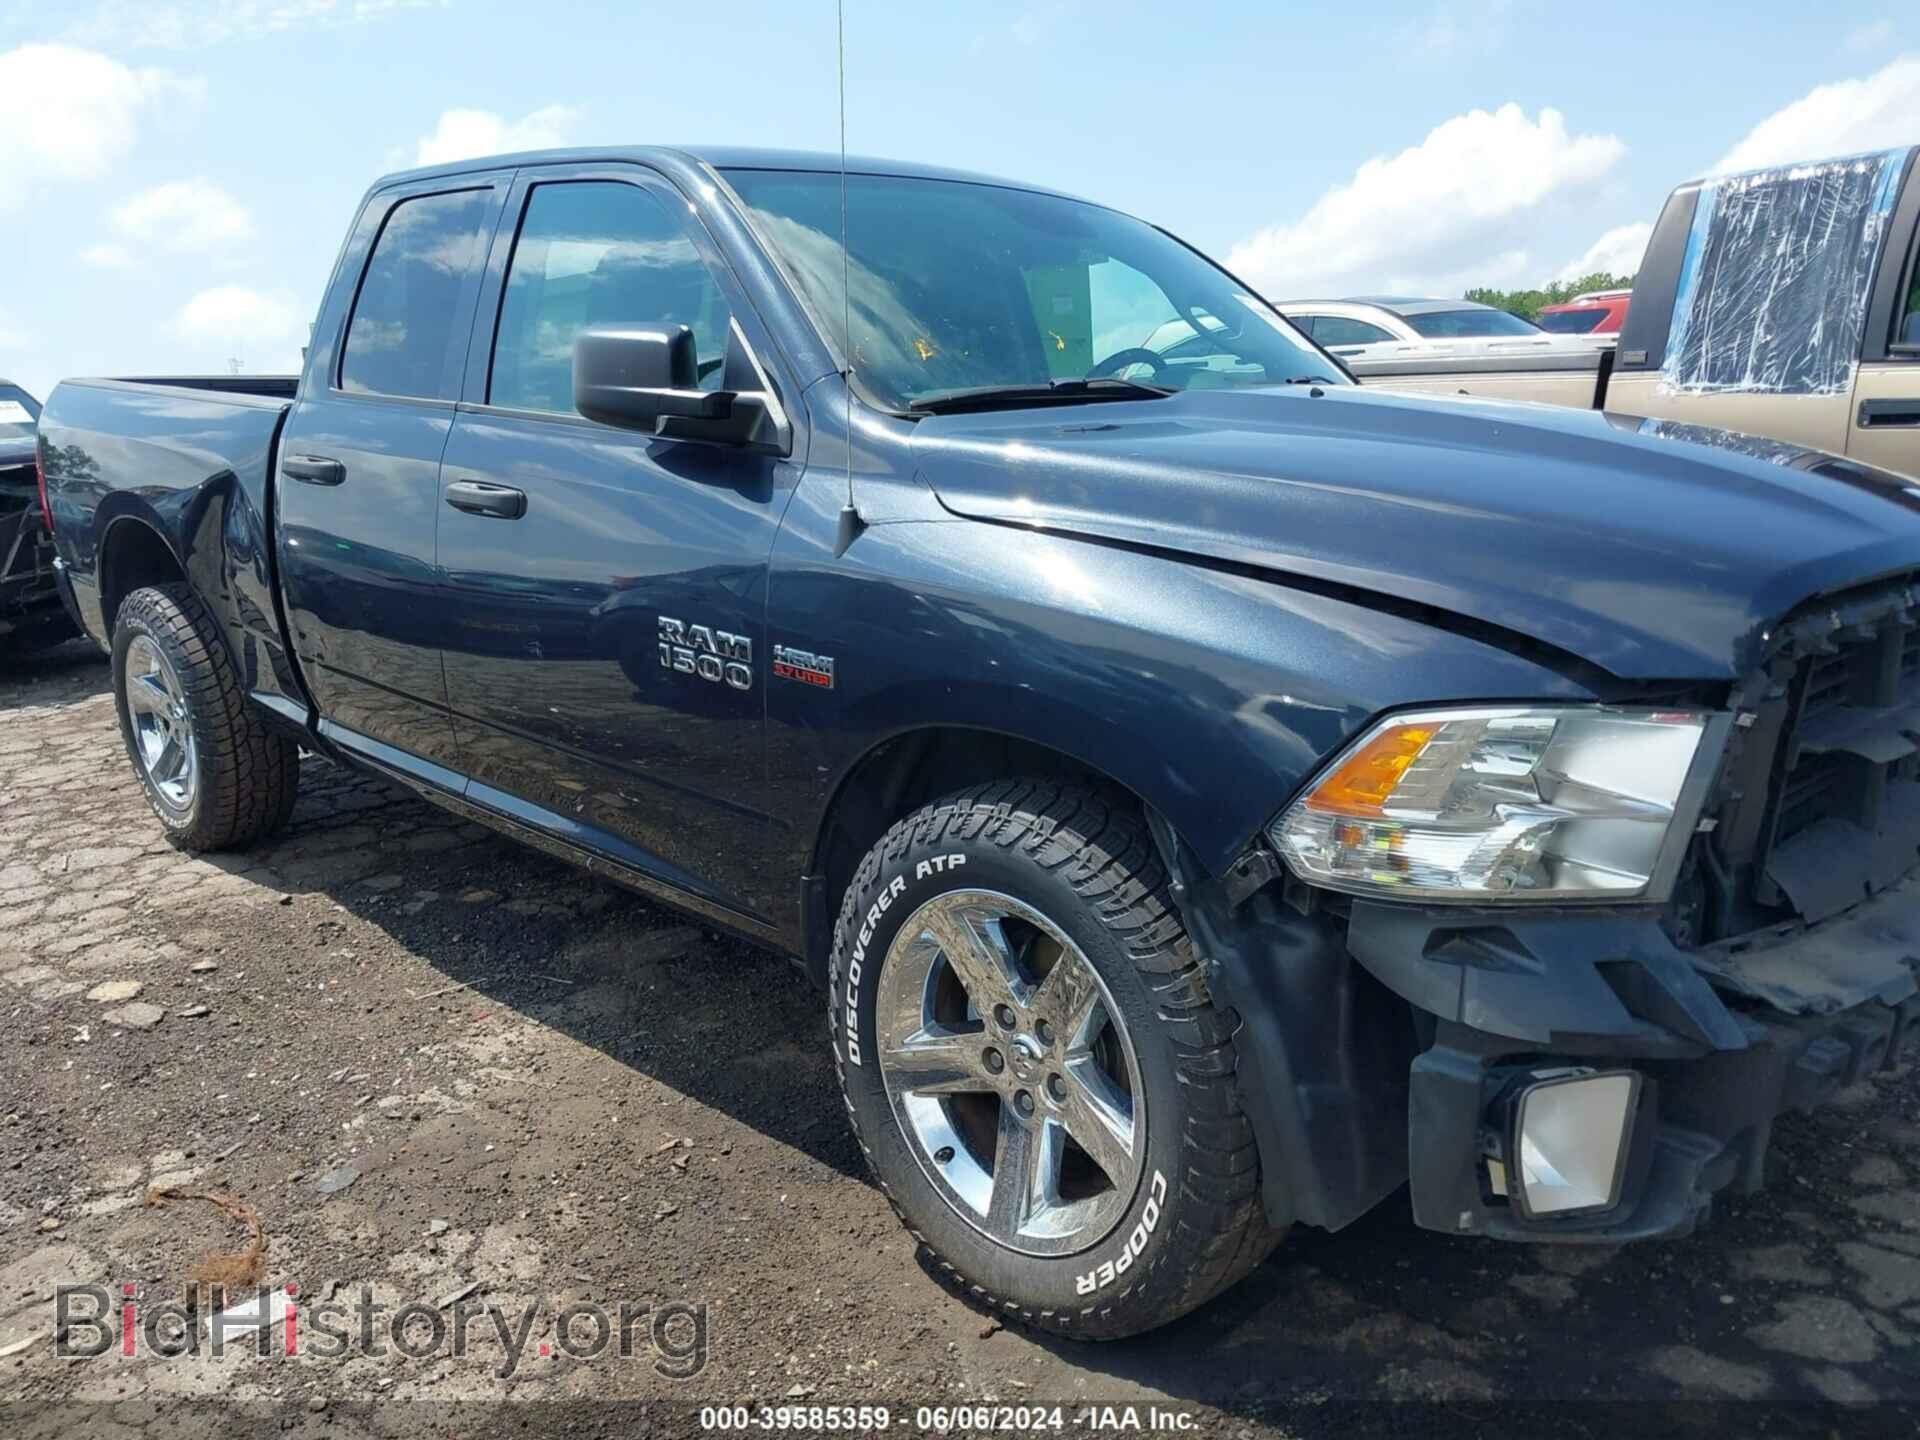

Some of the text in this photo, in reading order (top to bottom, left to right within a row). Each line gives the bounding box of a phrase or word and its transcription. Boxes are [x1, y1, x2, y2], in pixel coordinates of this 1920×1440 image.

[658, 615, 752, 663] RAM
[773, 644, 834, 674] HEMI
[658, 642, 753, 690] 1500
[795, 669, 829, 687] LITER
[849, 852, 967, 1067] DISCOVERER ATP
[1075, 1170, 1167, 1297] COOPER
